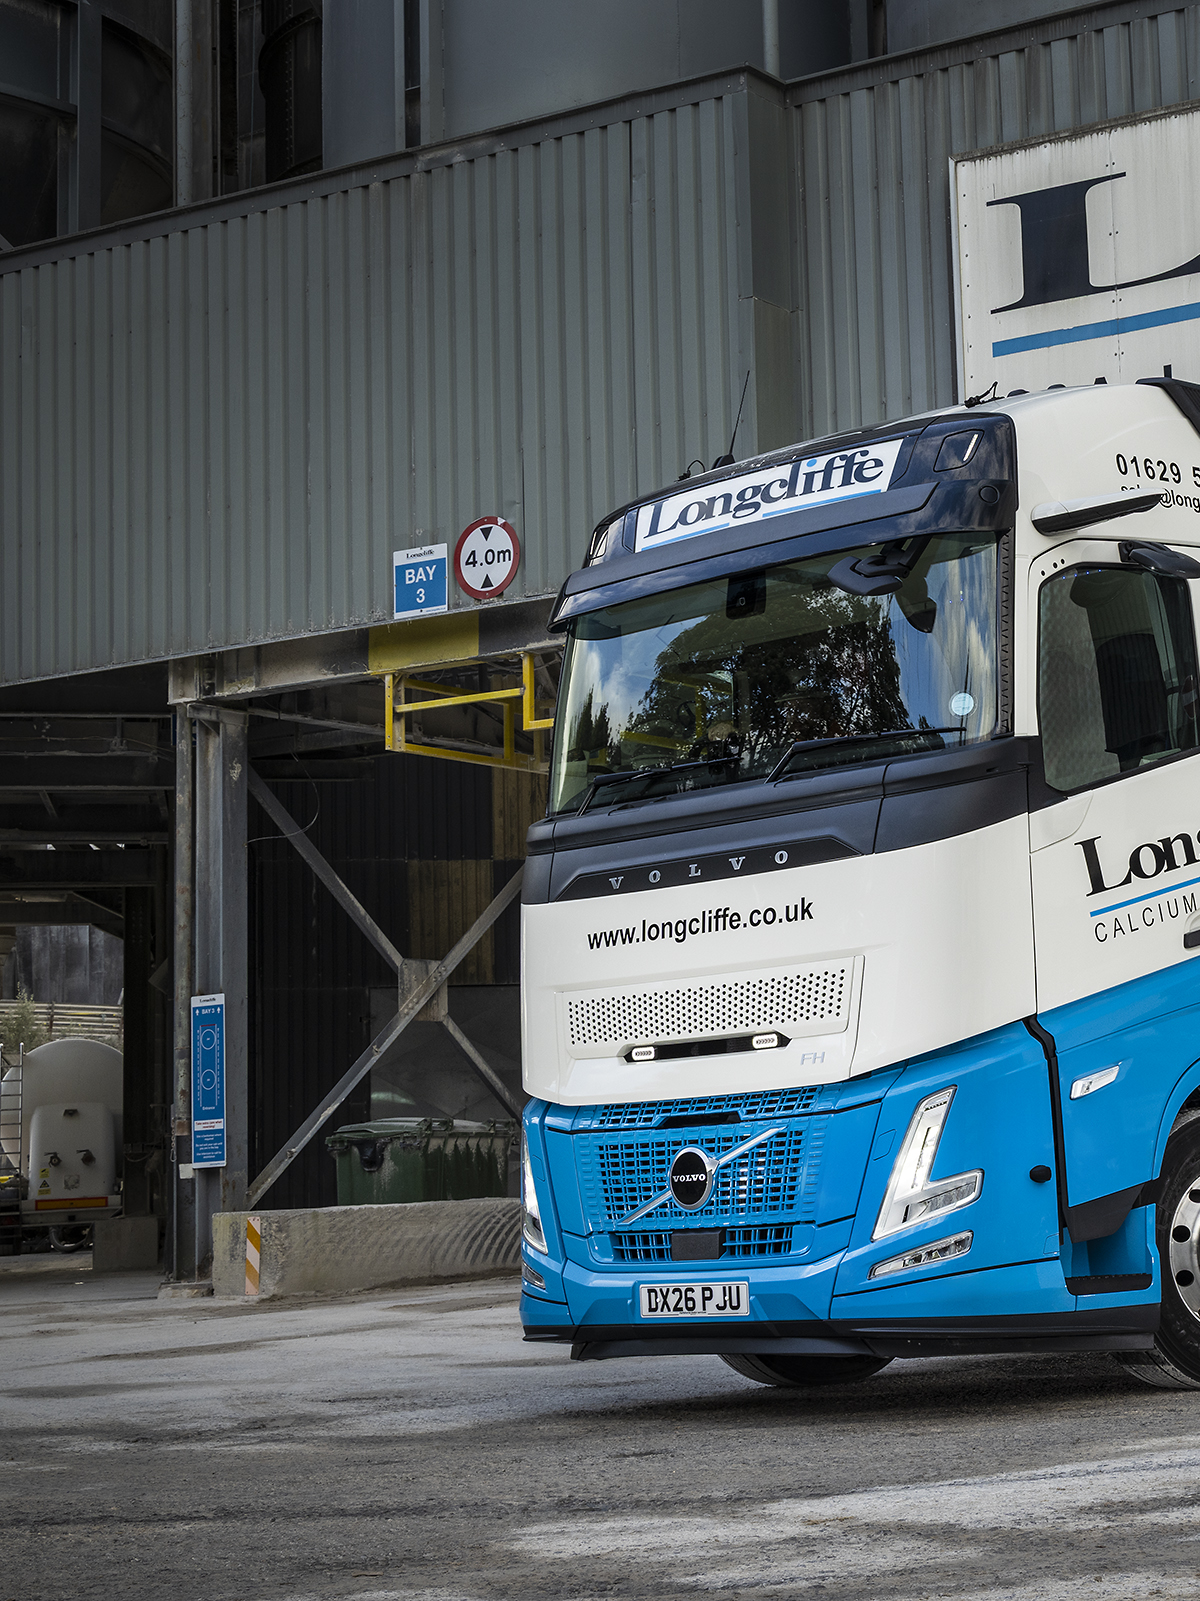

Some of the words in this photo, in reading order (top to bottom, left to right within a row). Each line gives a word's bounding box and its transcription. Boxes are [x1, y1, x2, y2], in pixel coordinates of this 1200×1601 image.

[1116, 453, 1181, 484] 01629
[643, 449, 884, 539] Longcliffe
[465, 548, 512, 567] 4.0m
[405, 565, 436, 584] BAY
[416, 588, 425, 603] 3
[609, 850, 789, 889] VOLVO
[587, 896, 814, 951] www.longcliffe.co.uk
[1095, 892, 1198, 942] CALCIUM
[800, 1052, 826, 1066] FH
[672, 1173, 706, 1182] VOLVO
[647, 1286, 696, 1313] DX26
[701, 1285, 741, 1311] PJU
